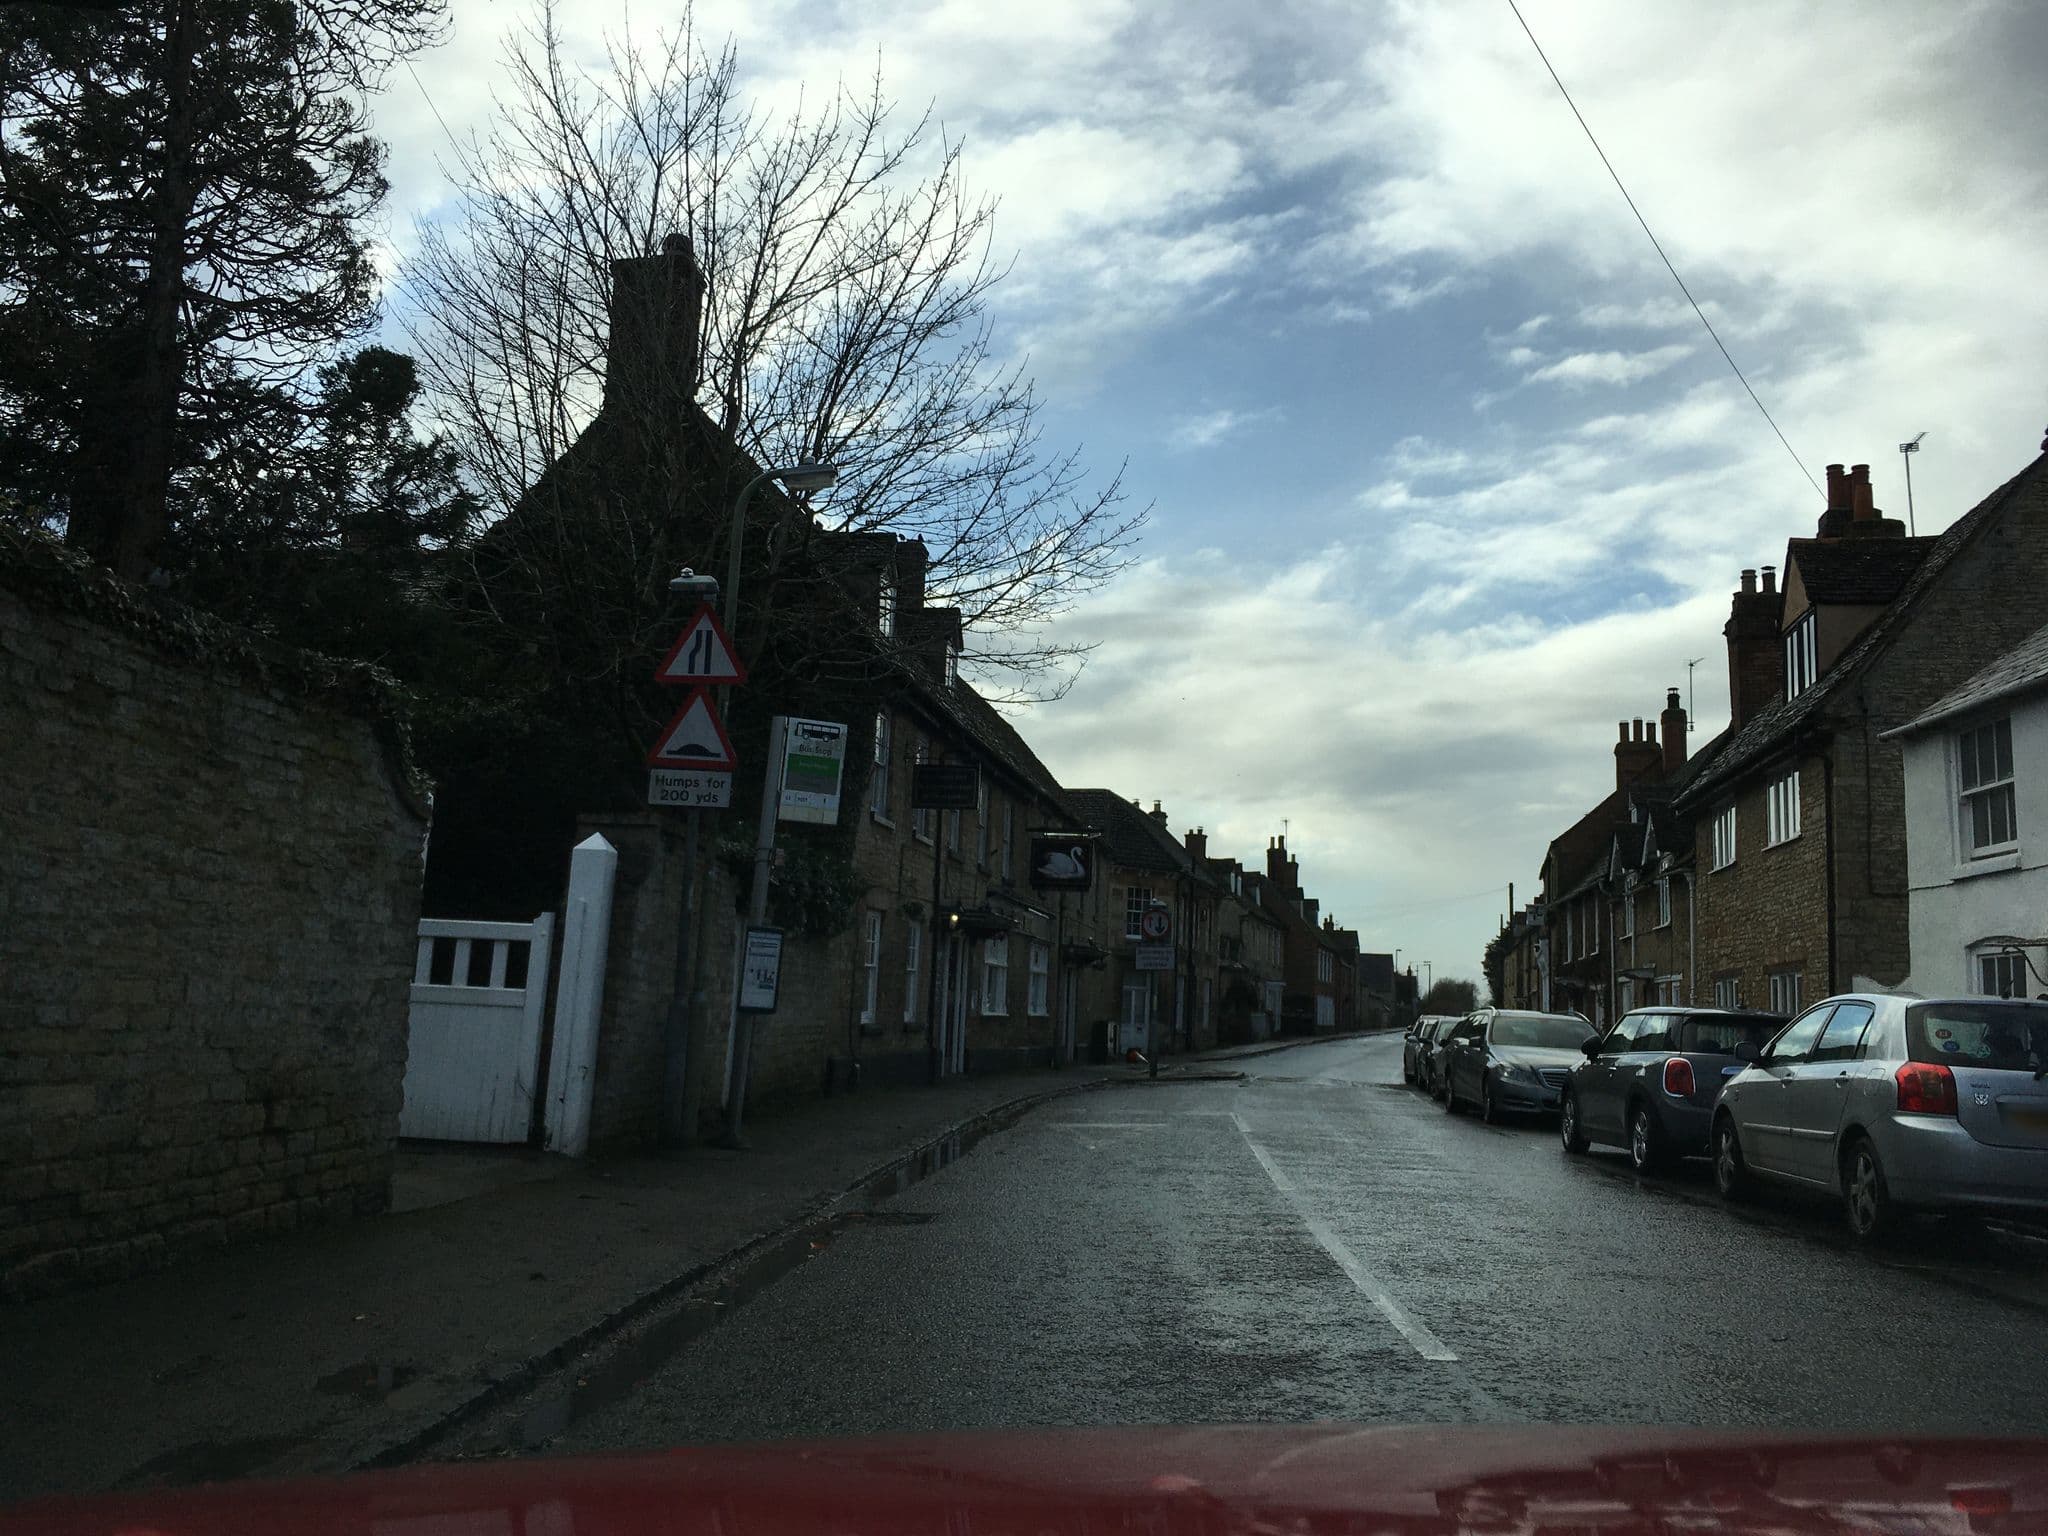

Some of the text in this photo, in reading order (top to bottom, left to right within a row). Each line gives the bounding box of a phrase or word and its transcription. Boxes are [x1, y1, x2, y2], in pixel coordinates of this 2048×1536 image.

[799, 743, 812, 753] Bus
[655, 774, 726, 789] Humps for
[660, 789, 719, 804] 200 yds
